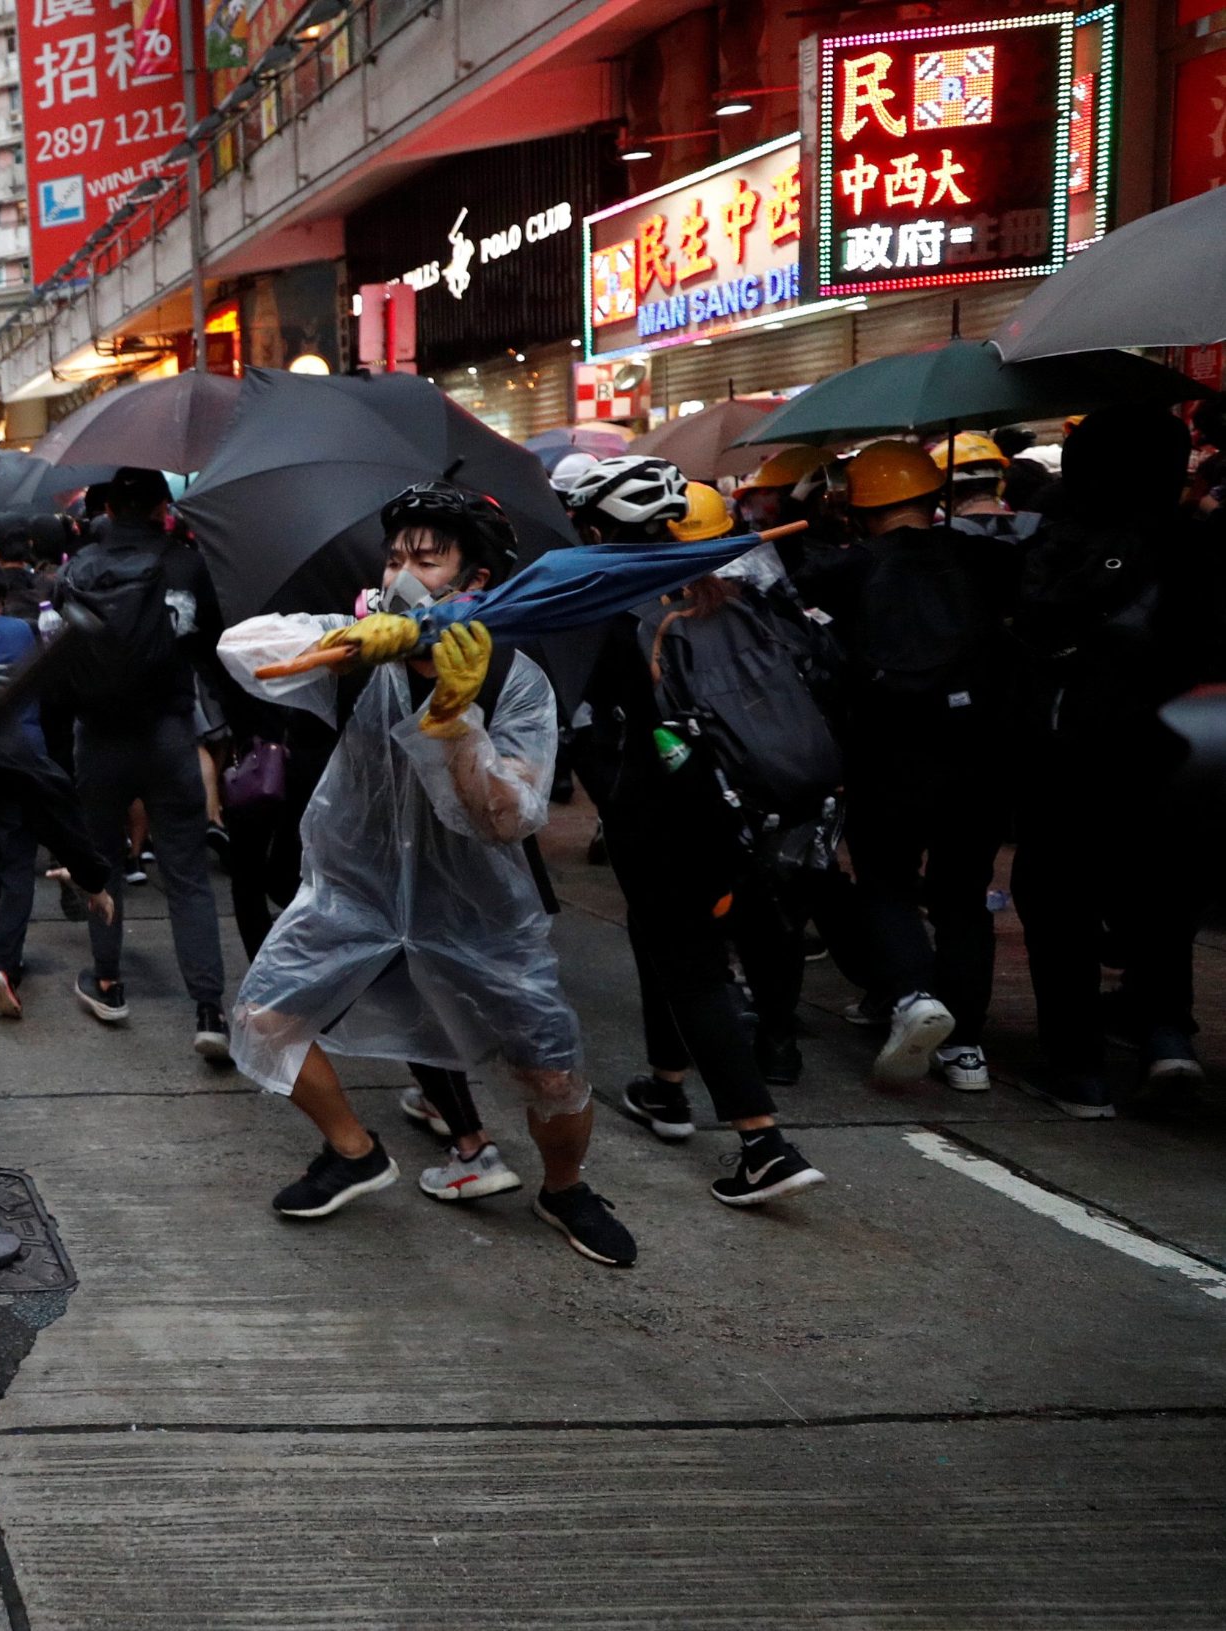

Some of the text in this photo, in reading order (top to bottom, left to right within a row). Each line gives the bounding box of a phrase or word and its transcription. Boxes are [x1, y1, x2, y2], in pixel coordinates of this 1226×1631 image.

[143, 29, 171, 57] 70
[840, 51, 907, 141] 民
[36, 102, 186, 162] 2897 1212
[840, 149, 971, 216] 中西大
[480, 224, 522, 264] POLO
[525, 201, 572, 243] CLUB
[637, 294, 688, 337] MAN
[688, 273, 760, 323] SANG
